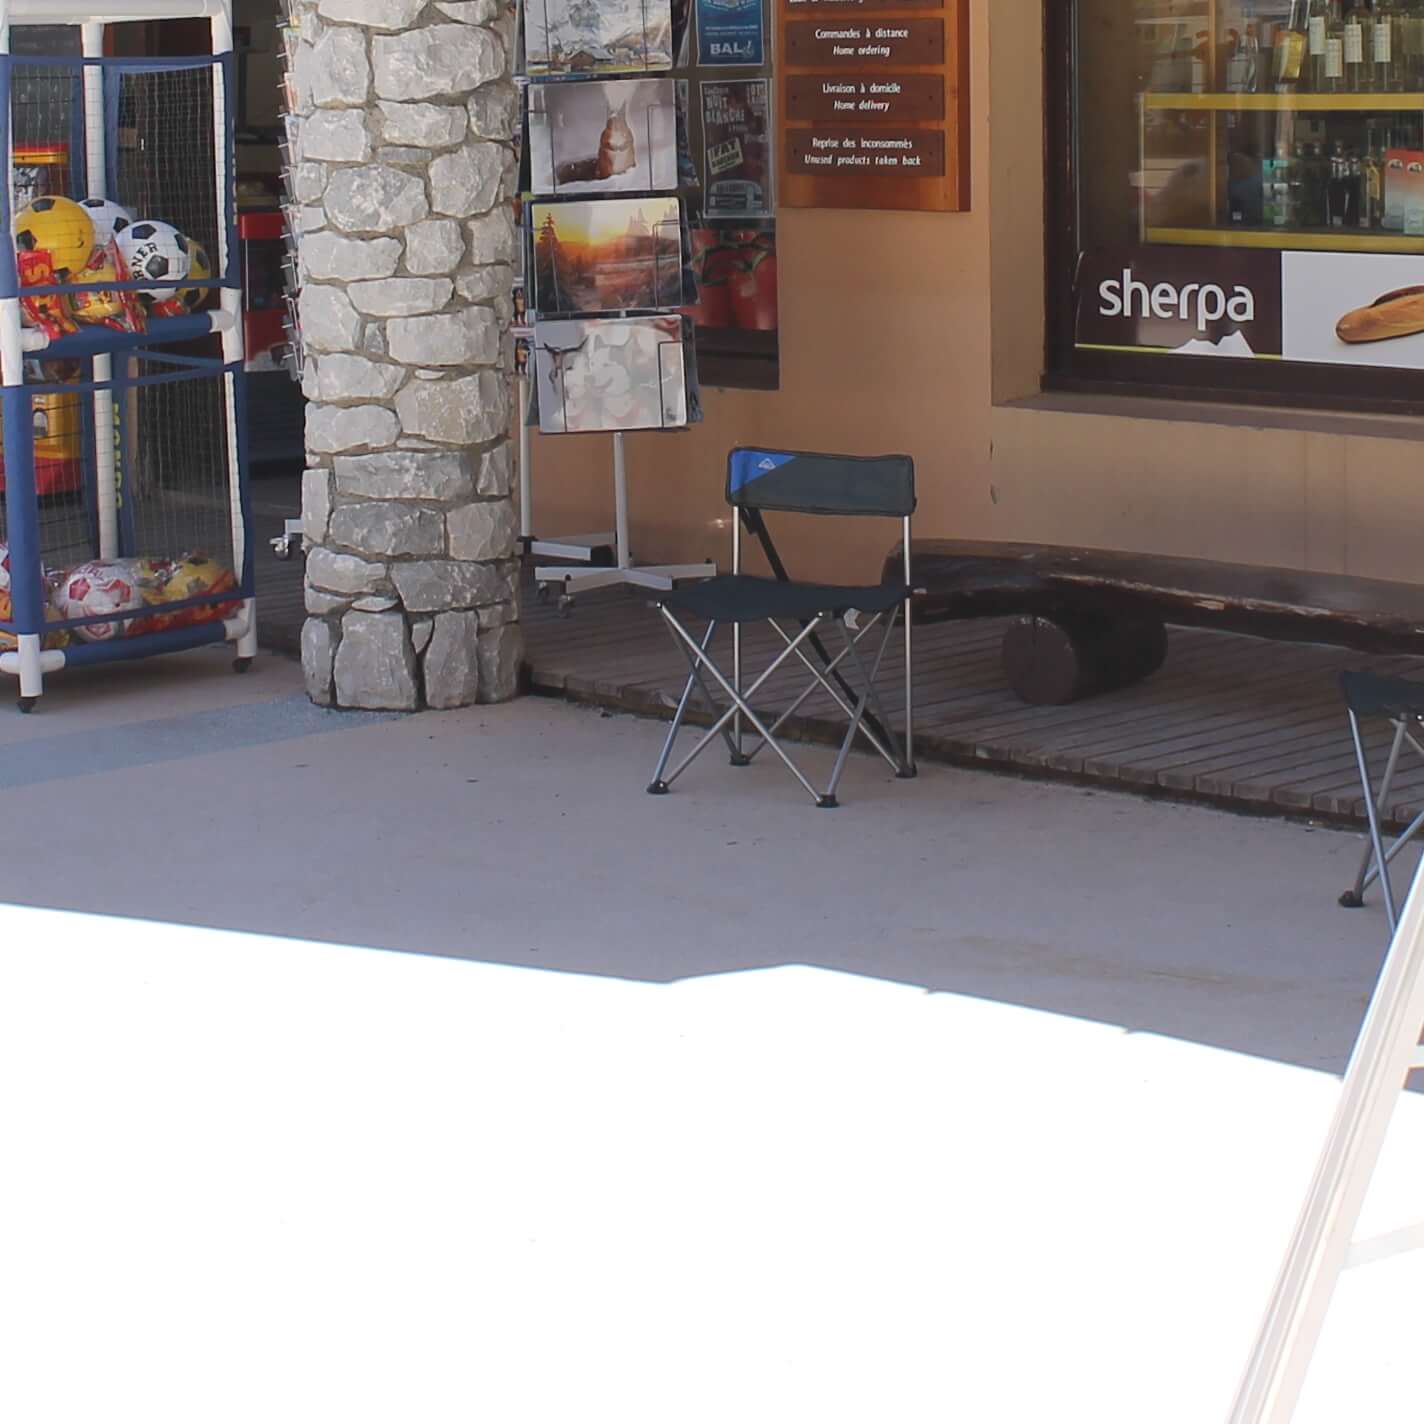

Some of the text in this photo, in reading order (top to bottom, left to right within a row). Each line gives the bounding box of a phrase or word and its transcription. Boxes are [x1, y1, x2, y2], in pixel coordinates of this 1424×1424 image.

[815, 28, 909, 39] Commandes à distance
[833, 45, 890, 57] Home ordering
[822, 83, 901, 94] Livraison à domicile
[834, 100, 890, 112] Home delivery
[812, 137, 839, 150] Reprise
[842, 138, 856, 148] des
[804, 154, 921, 167] Unused products taken back
[131, 241, 159, 280] RNER
[1099, 268, 1255, 332] sherpa
